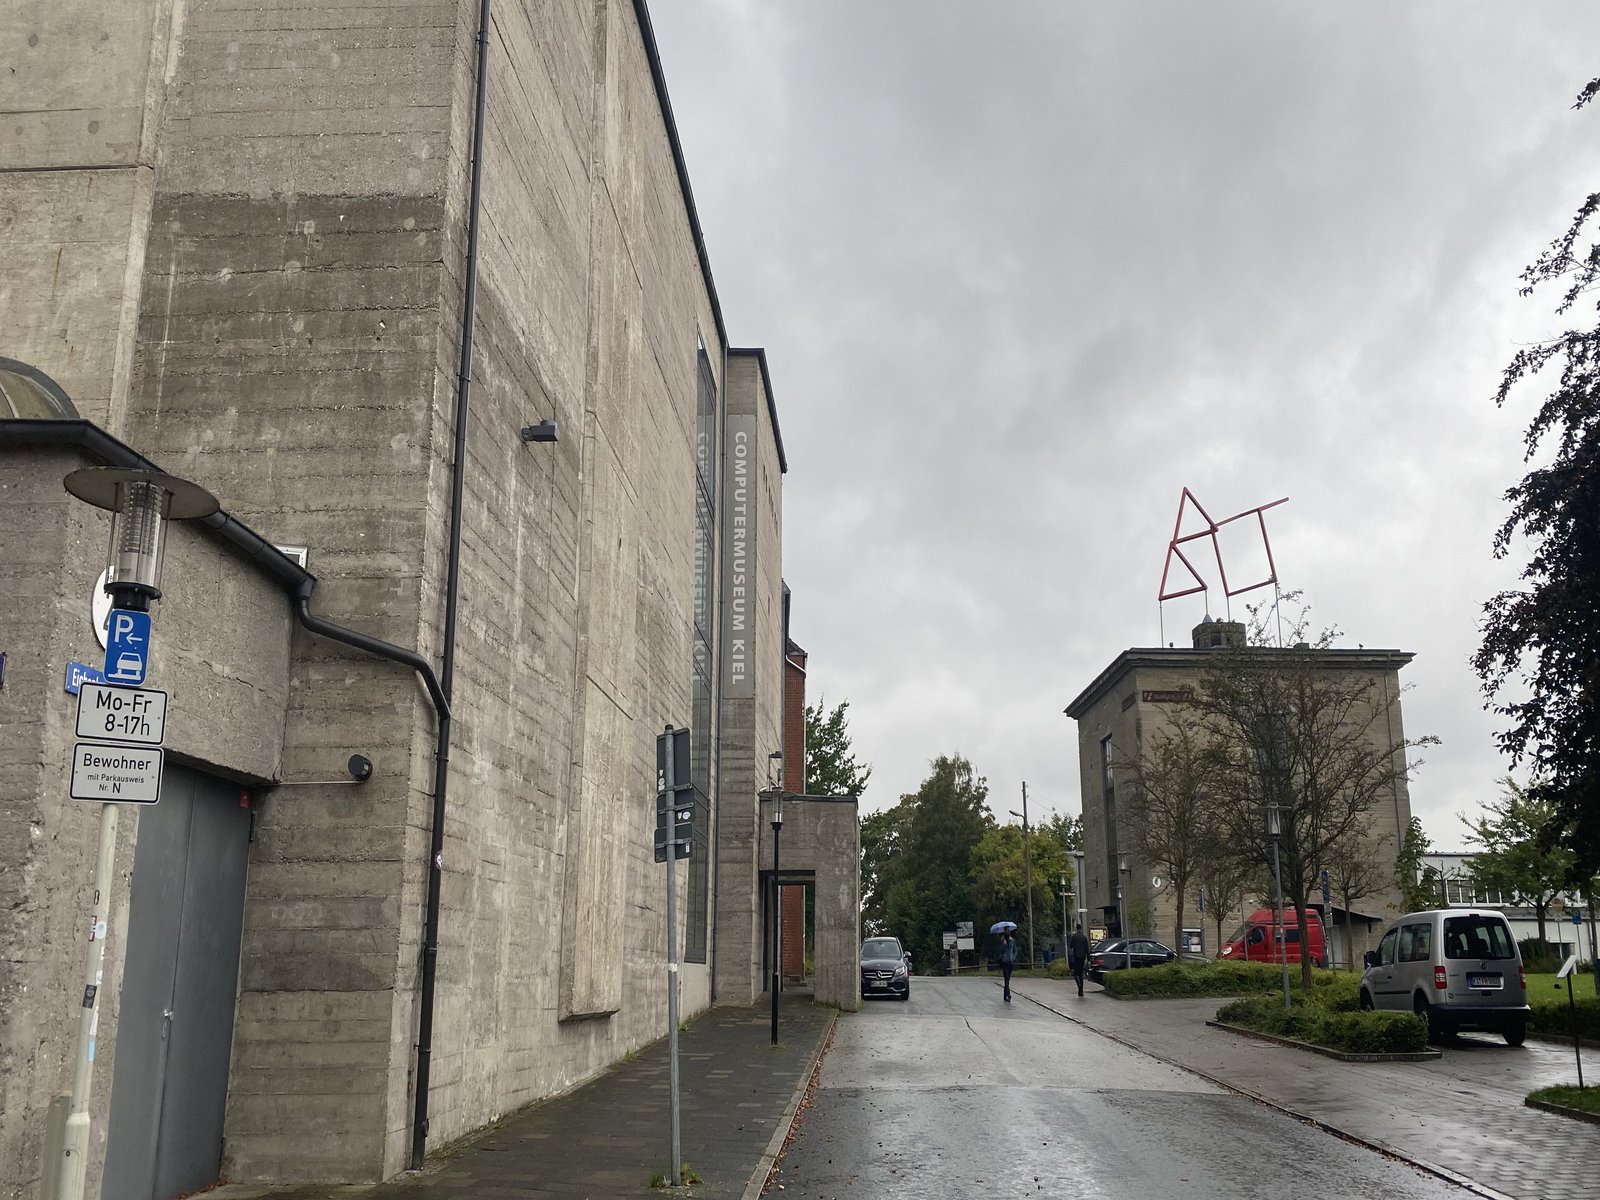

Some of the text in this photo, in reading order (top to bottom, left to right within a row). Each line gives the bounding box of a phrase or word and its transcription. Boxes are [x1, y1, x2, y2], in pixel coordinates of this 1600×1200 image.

[732, 431, 748, 685] COMPUTERMUSEUM KIEL
[114, 614, 134, 643] P
[96, 690, 152, 713] Mo-Fr
[105, 713, 150, 736] 8-17h
[83, 753, 151, 770] Bewohner
[99, 782, 121, 793] Nr. N
[101, 773, 144, 783] Parkausweis
